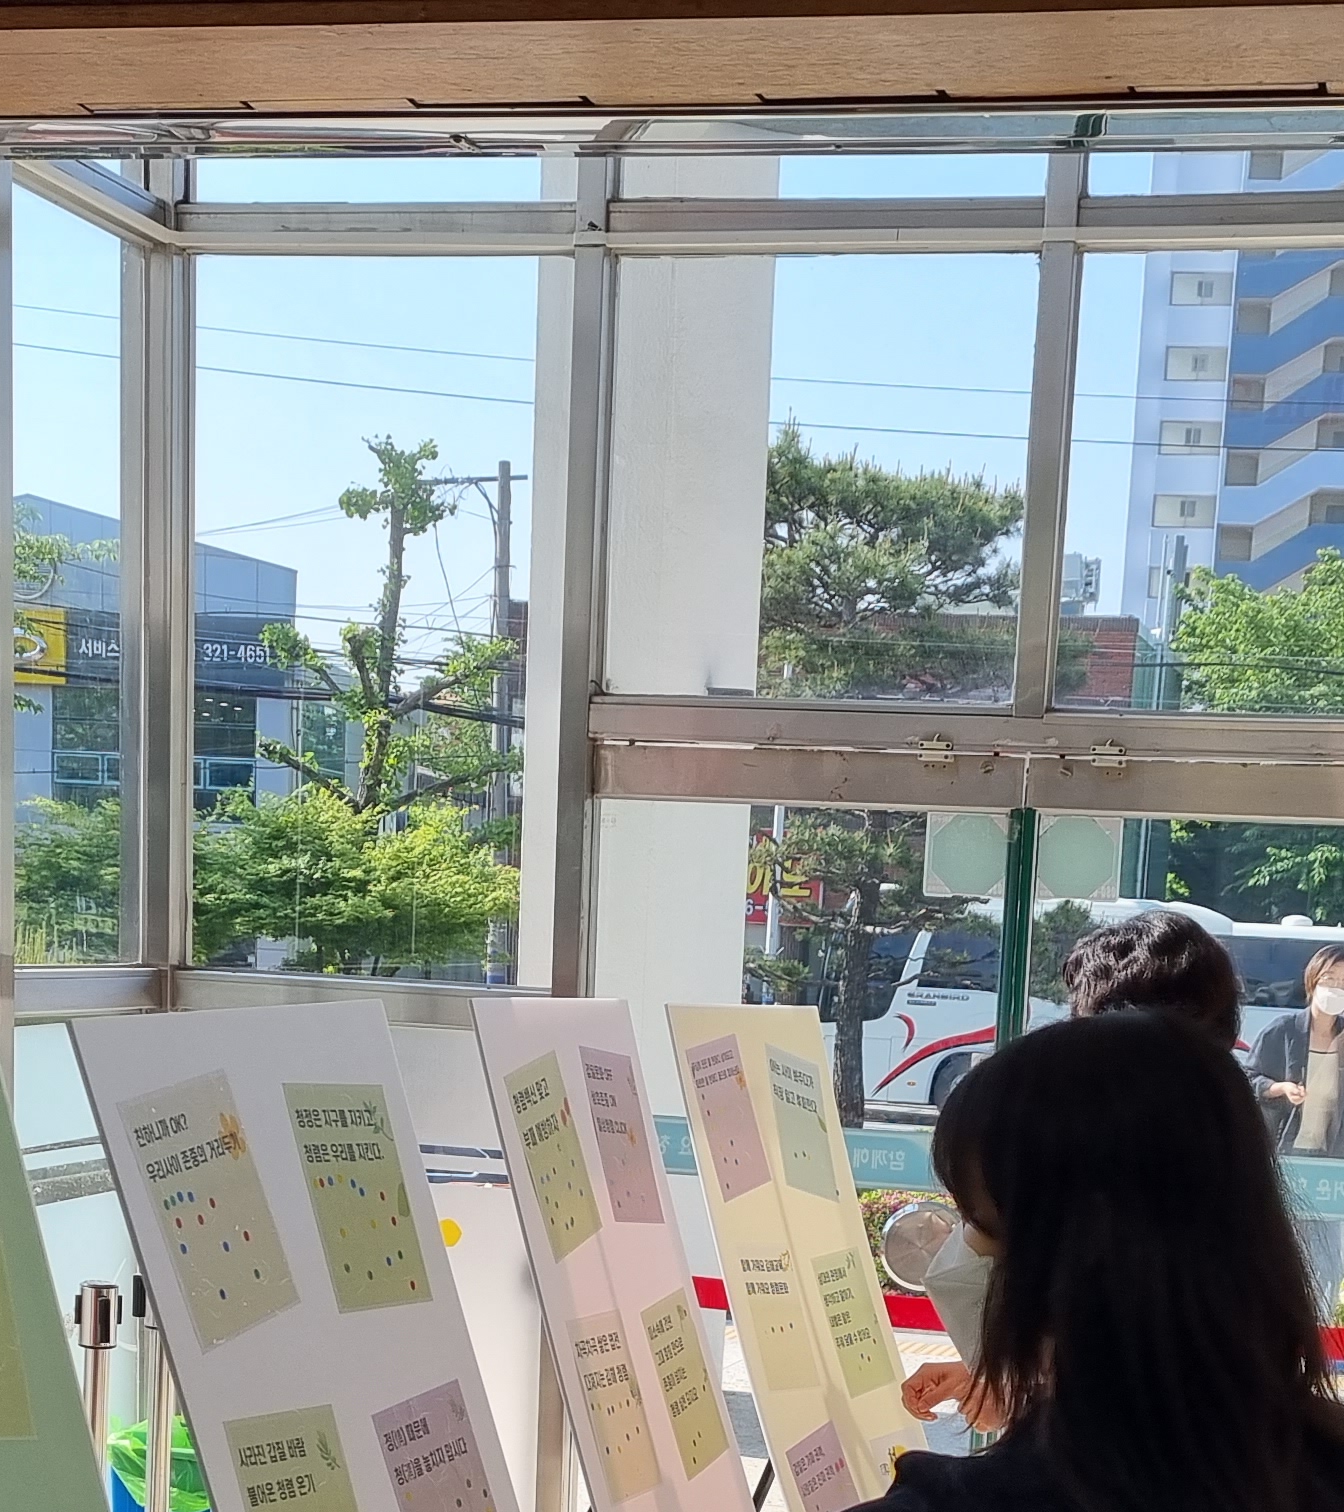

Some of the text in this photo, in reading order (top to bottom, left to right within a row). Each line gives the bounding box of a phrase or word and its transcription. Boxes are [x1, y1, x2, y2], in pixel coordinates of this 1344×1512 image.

[79, 638, 120, 658] 서비스
[203, 643, 270, 662] 321-4651
[133, 1113, 189, 1148] 친하니까 OK?
[323, 1108, 348, 1128] 지구를
[348, 1108, 375, 1128] 지키고
[146, 1131, 242, 1182] 우리사이 존중의 거리두기
[304, 1143, 385, 1163] 청렴은 우리를 지킨다.
[407, 1417, 430, 1442] 때문에
[238, 1436, 307, 1468] 사라진 갑질 바람
[422, 1447, 445, 1473] 놓치지
[276, 1477, 296, 1501] 청렴
[296, 1473, 317, 1495] 온기
